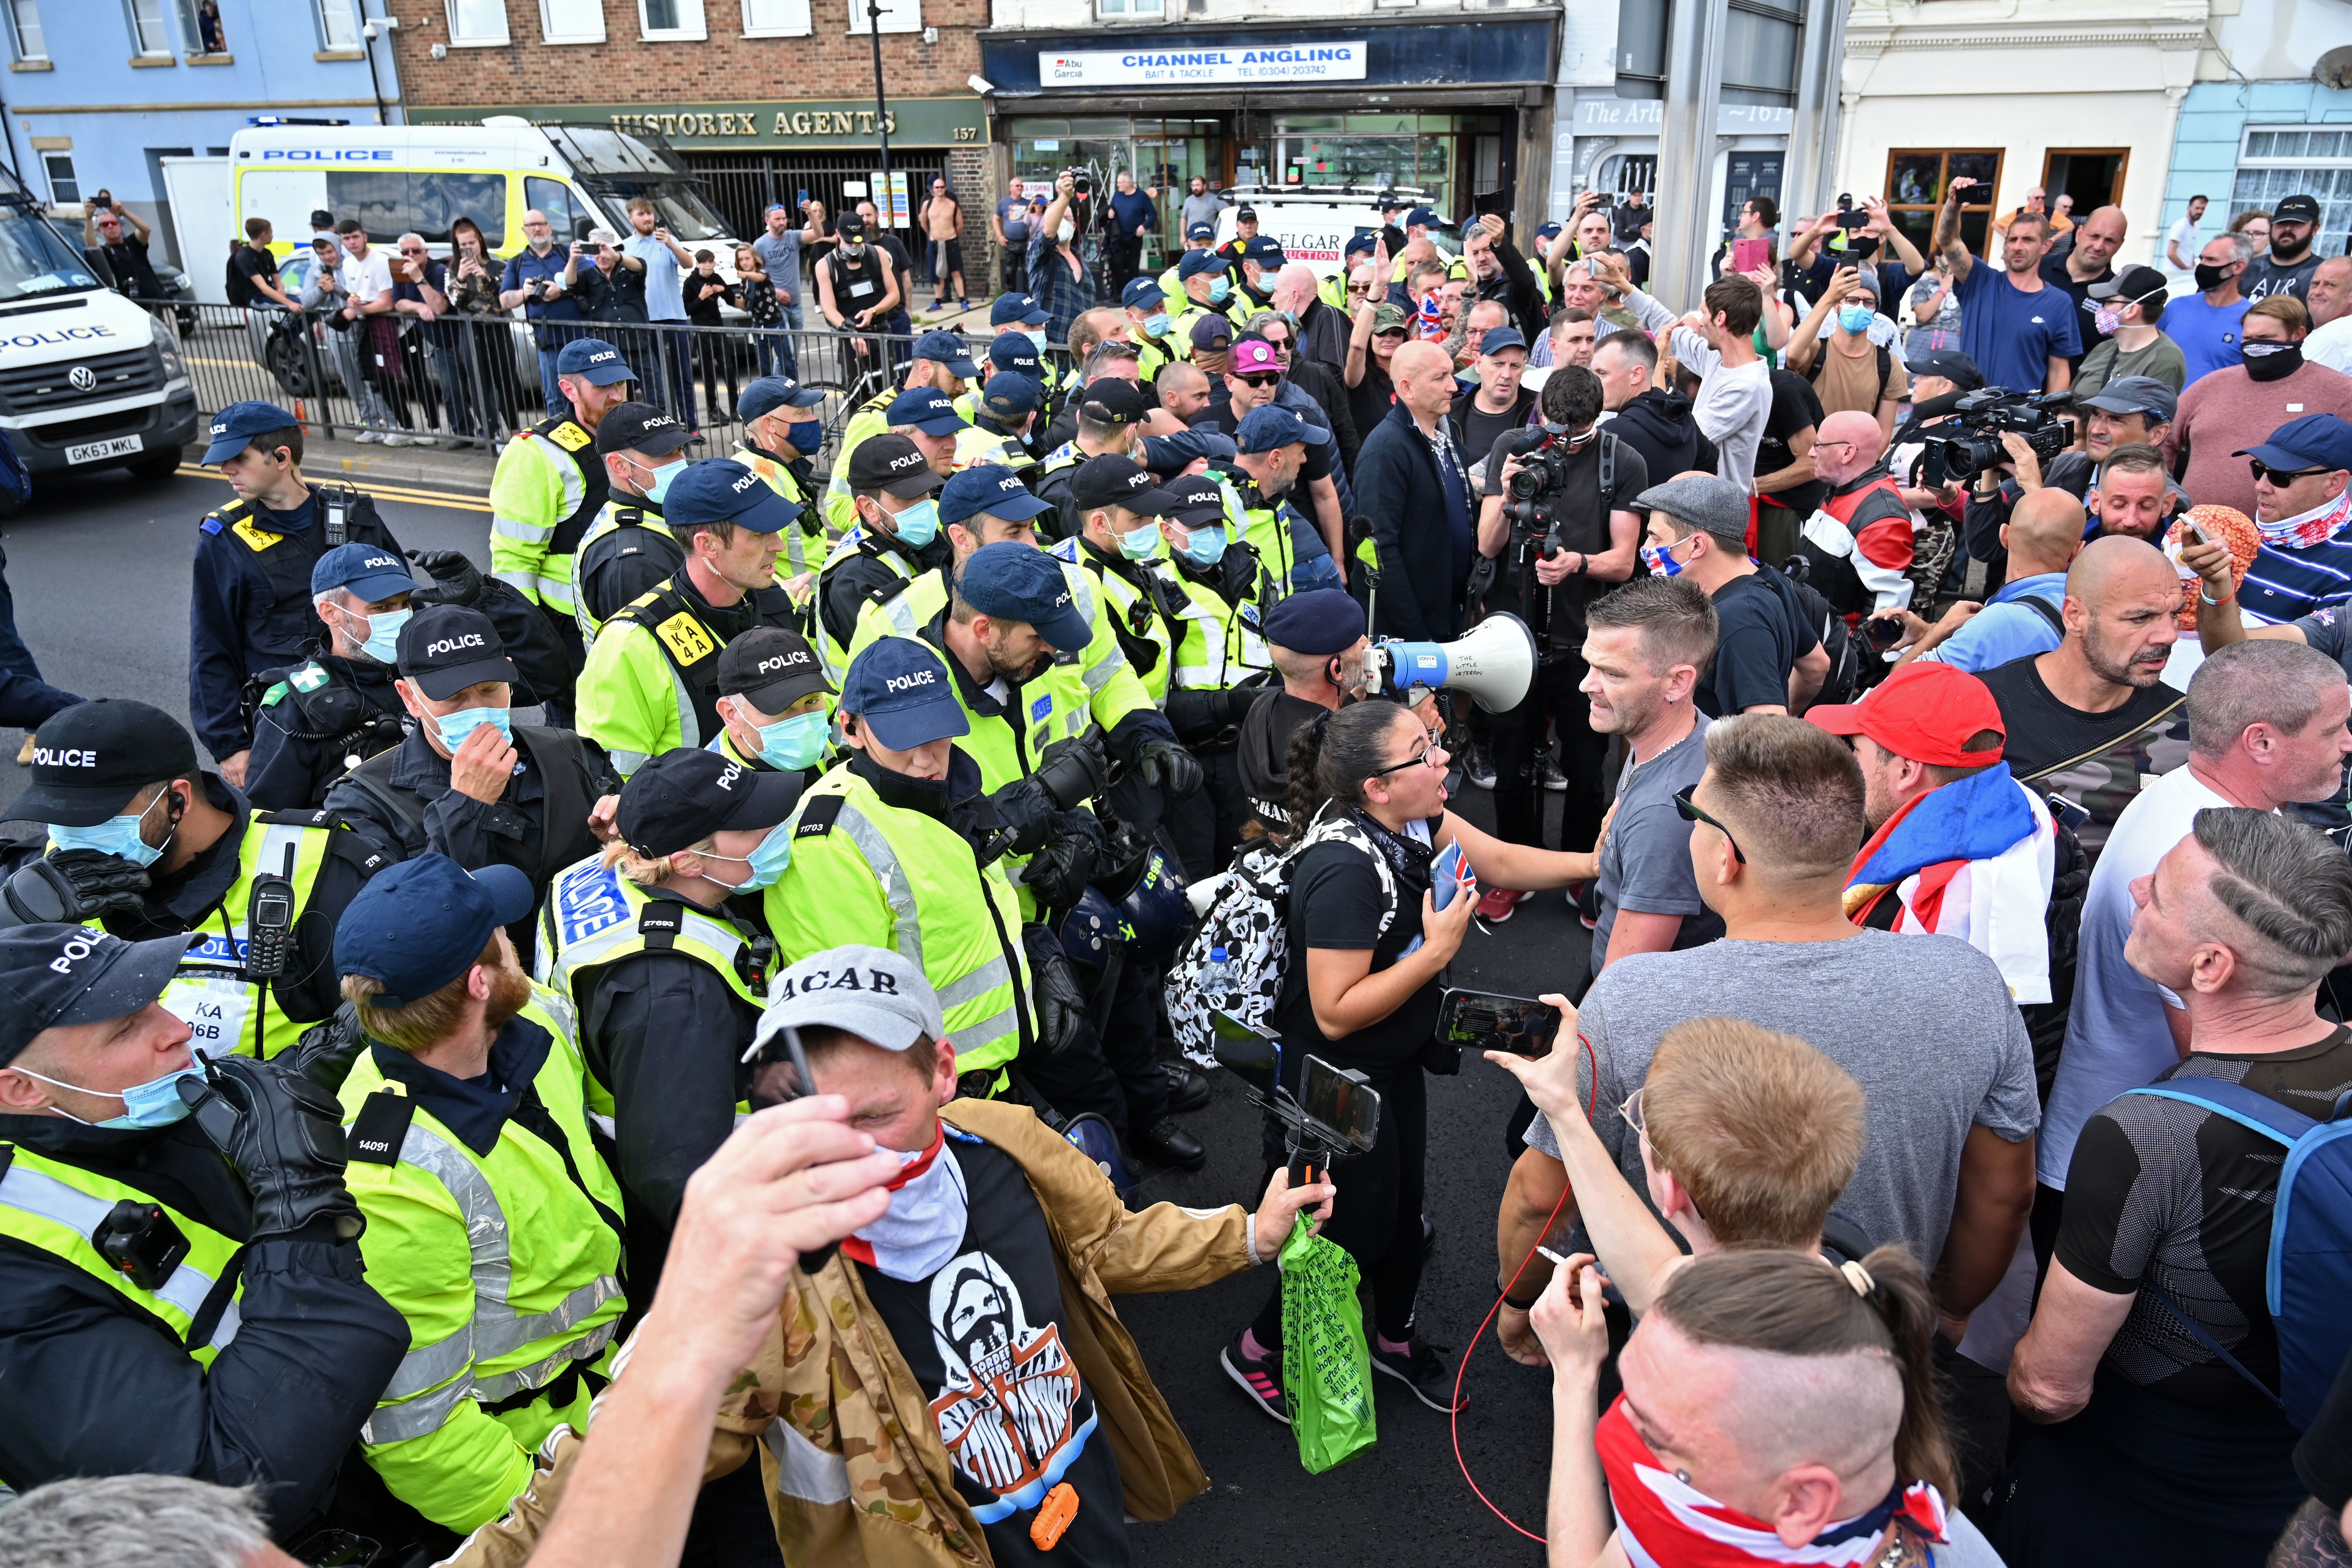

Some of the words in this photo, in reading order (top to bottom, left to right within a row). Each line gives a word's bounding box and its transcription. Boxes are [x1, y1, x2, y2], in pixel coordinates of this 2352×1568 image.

[1122, 53, 1233, 67] CHANNEL
[1242, 49, 1351, 64] ANGLING
[1054, 69, 1083, 78] Garcia
[1145, 70, 1166, 79] BAIT
[1169, 69, 1175, 79] &
[1179, 68, 1214, 78] TACKLE
[1237, 67, 1257, 77] TEL.
[1259, 66, 1290, 77] (0304)
[1292, 65, 1326, 75] 203742
[1584, 102, 1621, 123] The
[610, 112, 758, 136] HISTOREX
[773, 111, 896, 135] AGENTS
[953, 127, 977, 140] 157
[264, 151, 394, 160] POLICE
[1280, 234, 1340, 249] ELGAR
[1283, 250, 1337, 260] RUCTION
[2250, 278, 2296, 296] AIR
[590, 351, 616, 363] POLICE
[643, 415, 676, 430] POLIC
[72, 444, 109, 461] GK63
[113, 439, 138, 455] MKL
[890, 452, 923, 471] POLICE
[1188, 492, 1220, 504] POLICE
[365, 556, 399, 568] POLICE
[1056, 589, 1071, 608] POL
[1244, 605, 1259, 626] POLICE
[428, 634, 485, 657] POLICE
[758, 651, 811, 674] POLICE
[886, 670, 935, 693] POLICE
[339, 729, 363, 746] 11661
[33, 748, 97, 767] POLICE
[716, 760, 742, 791] POL
[800, 823, 823, 833] 11703
[1143, 855, 1164, 890] 10687
[775, 967, 899, 1006] ACAB
[196, 1002, 223, 1020] KA
[359, 1139, 389, 1153] 14091
[1324, 1363, 1341, 1384] after
[1330, 1375, 1349, 1396] AFTER
[1339, 1384, 1359, 1405] after
